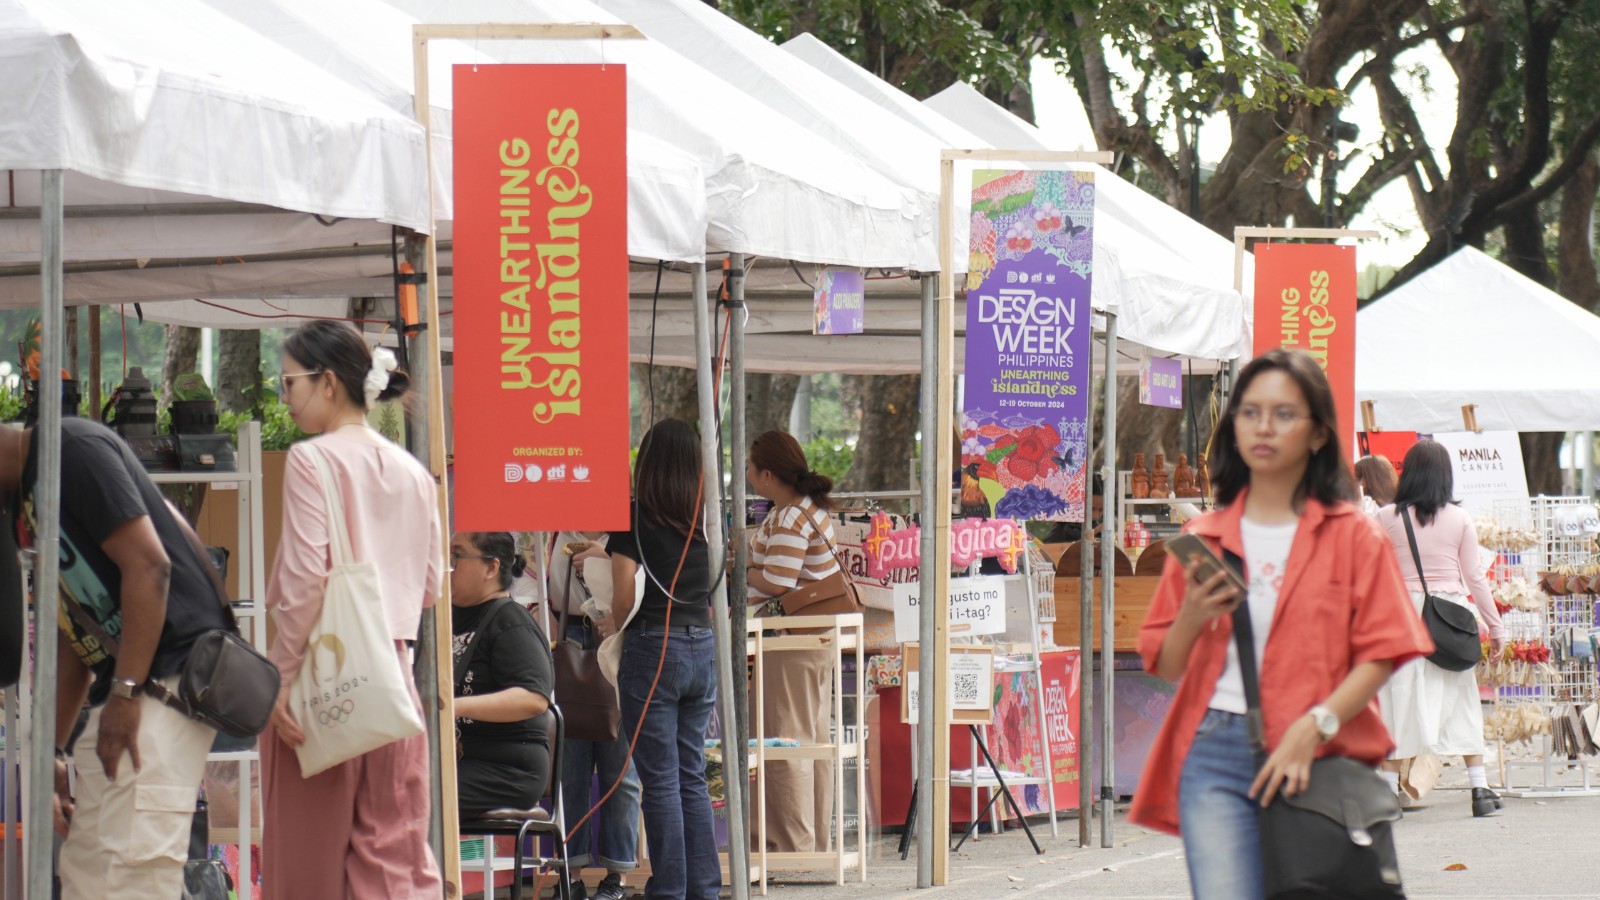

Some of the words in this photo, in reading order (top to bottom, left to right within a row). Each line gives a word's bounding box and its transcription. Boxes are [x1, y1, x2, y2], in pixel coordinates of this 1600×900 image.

[499, 137, 532, 390] UNEARTHING
[532, 107, 593, 424] islandness
[978, 289, 1076, 325] DESIGN
[992, 324, 1075, 354] WEEK
[998, 354, 1074, 368] PHILIPPINES
[1001, 369, 1070, 381] UNEARTHING
[991, 378, 1077, 398] islandness
[1047, 401, 1065, 409] 2024
[512, 448, 565, 456] ORGANIZED
[567, 448, 583, 456] BY:
[1459, 448, 1502, 462] MANILA
[1461, 462, 1504, 472] CANVAS
[983, 590, 998, 600] mo
[956, 604, 991, 620] i-tag?
[1045, 681, 1068, 714] DESIGN
[1047, 714, 1075, 743] WEEK
